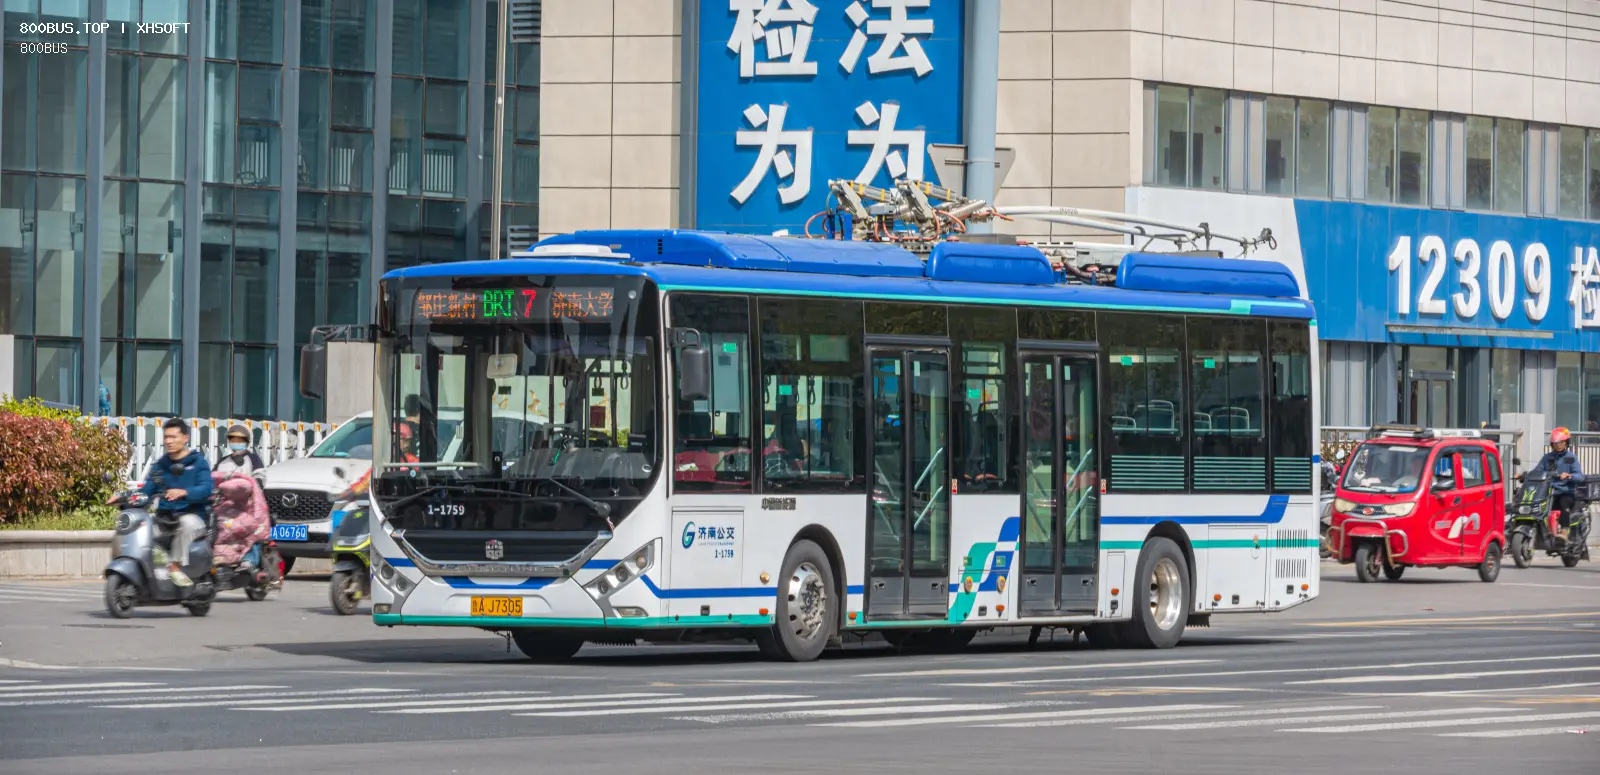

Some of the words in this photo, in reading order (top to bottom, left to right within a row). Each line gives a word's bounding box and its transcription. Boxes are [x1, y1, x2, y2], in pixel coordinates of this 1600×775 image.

[483, 289, 515, 317] BRT
[521, 289, 537, 318] 7
[552, 290, 614, 318] 济南大学
[427, 504, 465, 516] 1-1759
[698, 526, 735, 540] 济南公交
[714, 549, 734, 558] 1-1759
